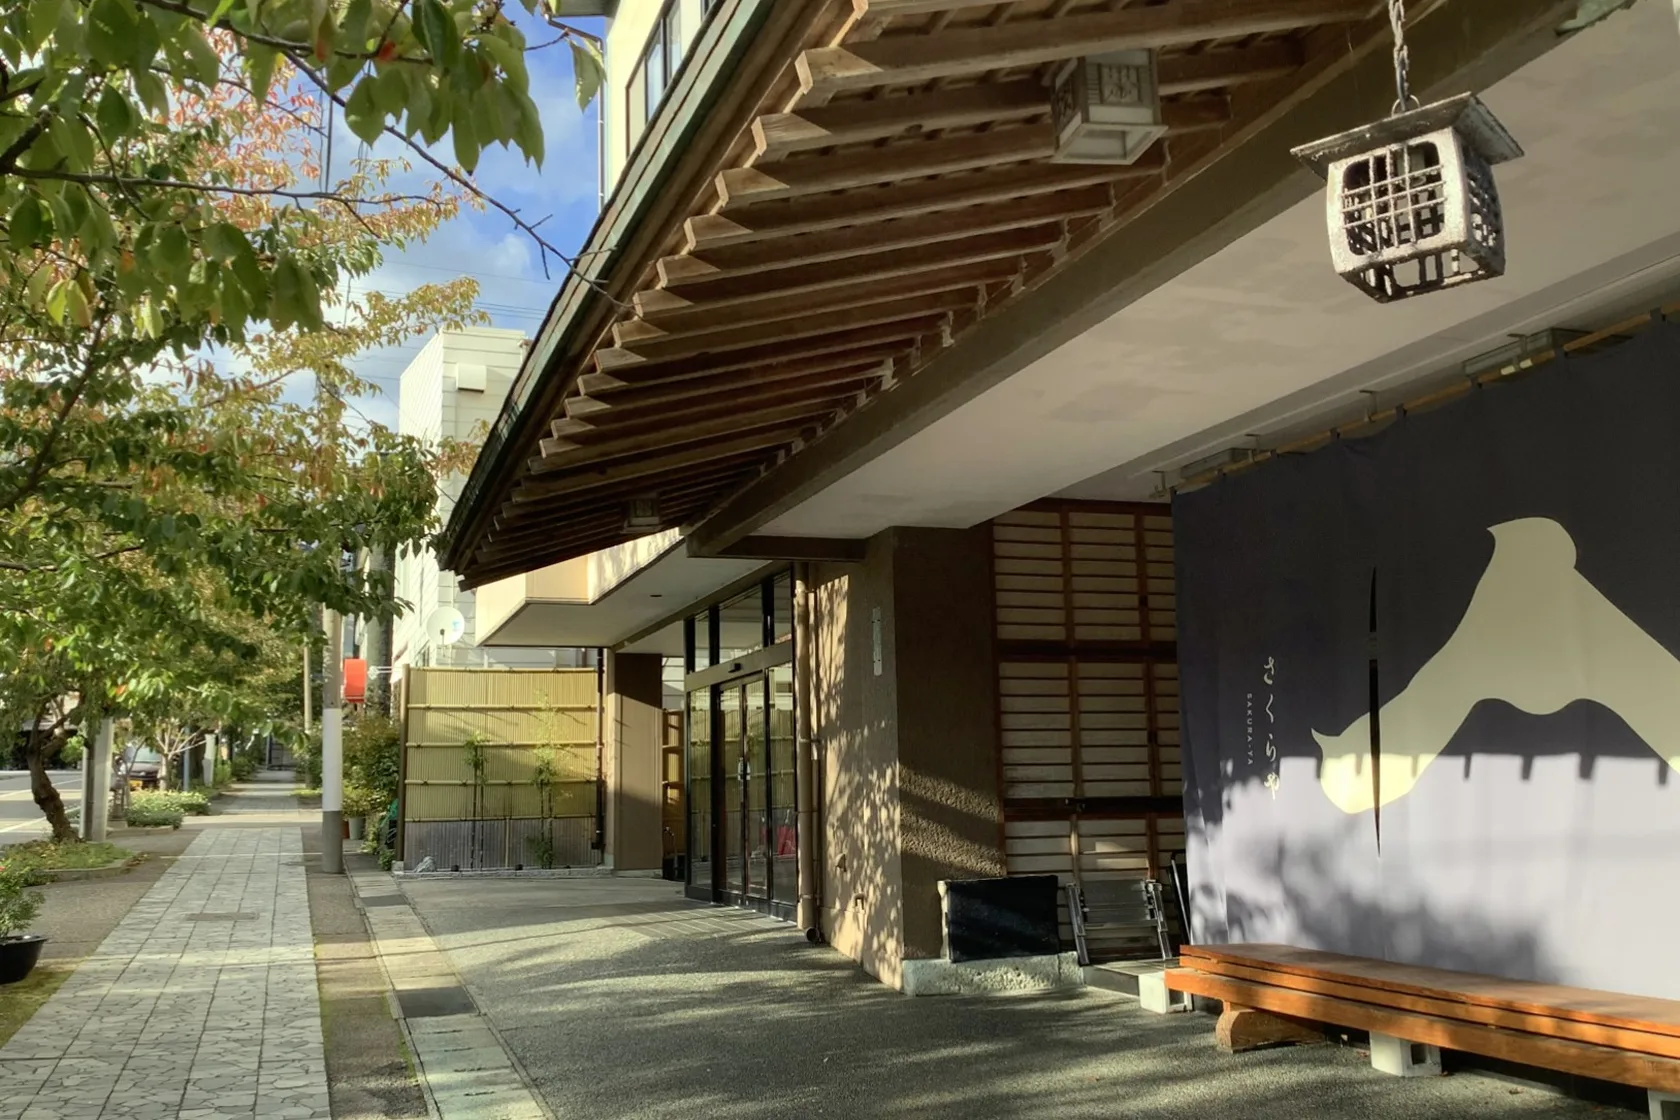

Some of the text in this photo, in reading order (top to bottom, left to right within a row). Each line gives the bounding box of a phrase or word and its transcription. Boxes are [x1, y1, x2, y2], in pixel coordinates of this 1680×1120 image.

[1246, 693, 1254, 764] SAKURA-YA
[1263, 656, 1280, 801] さくらや
